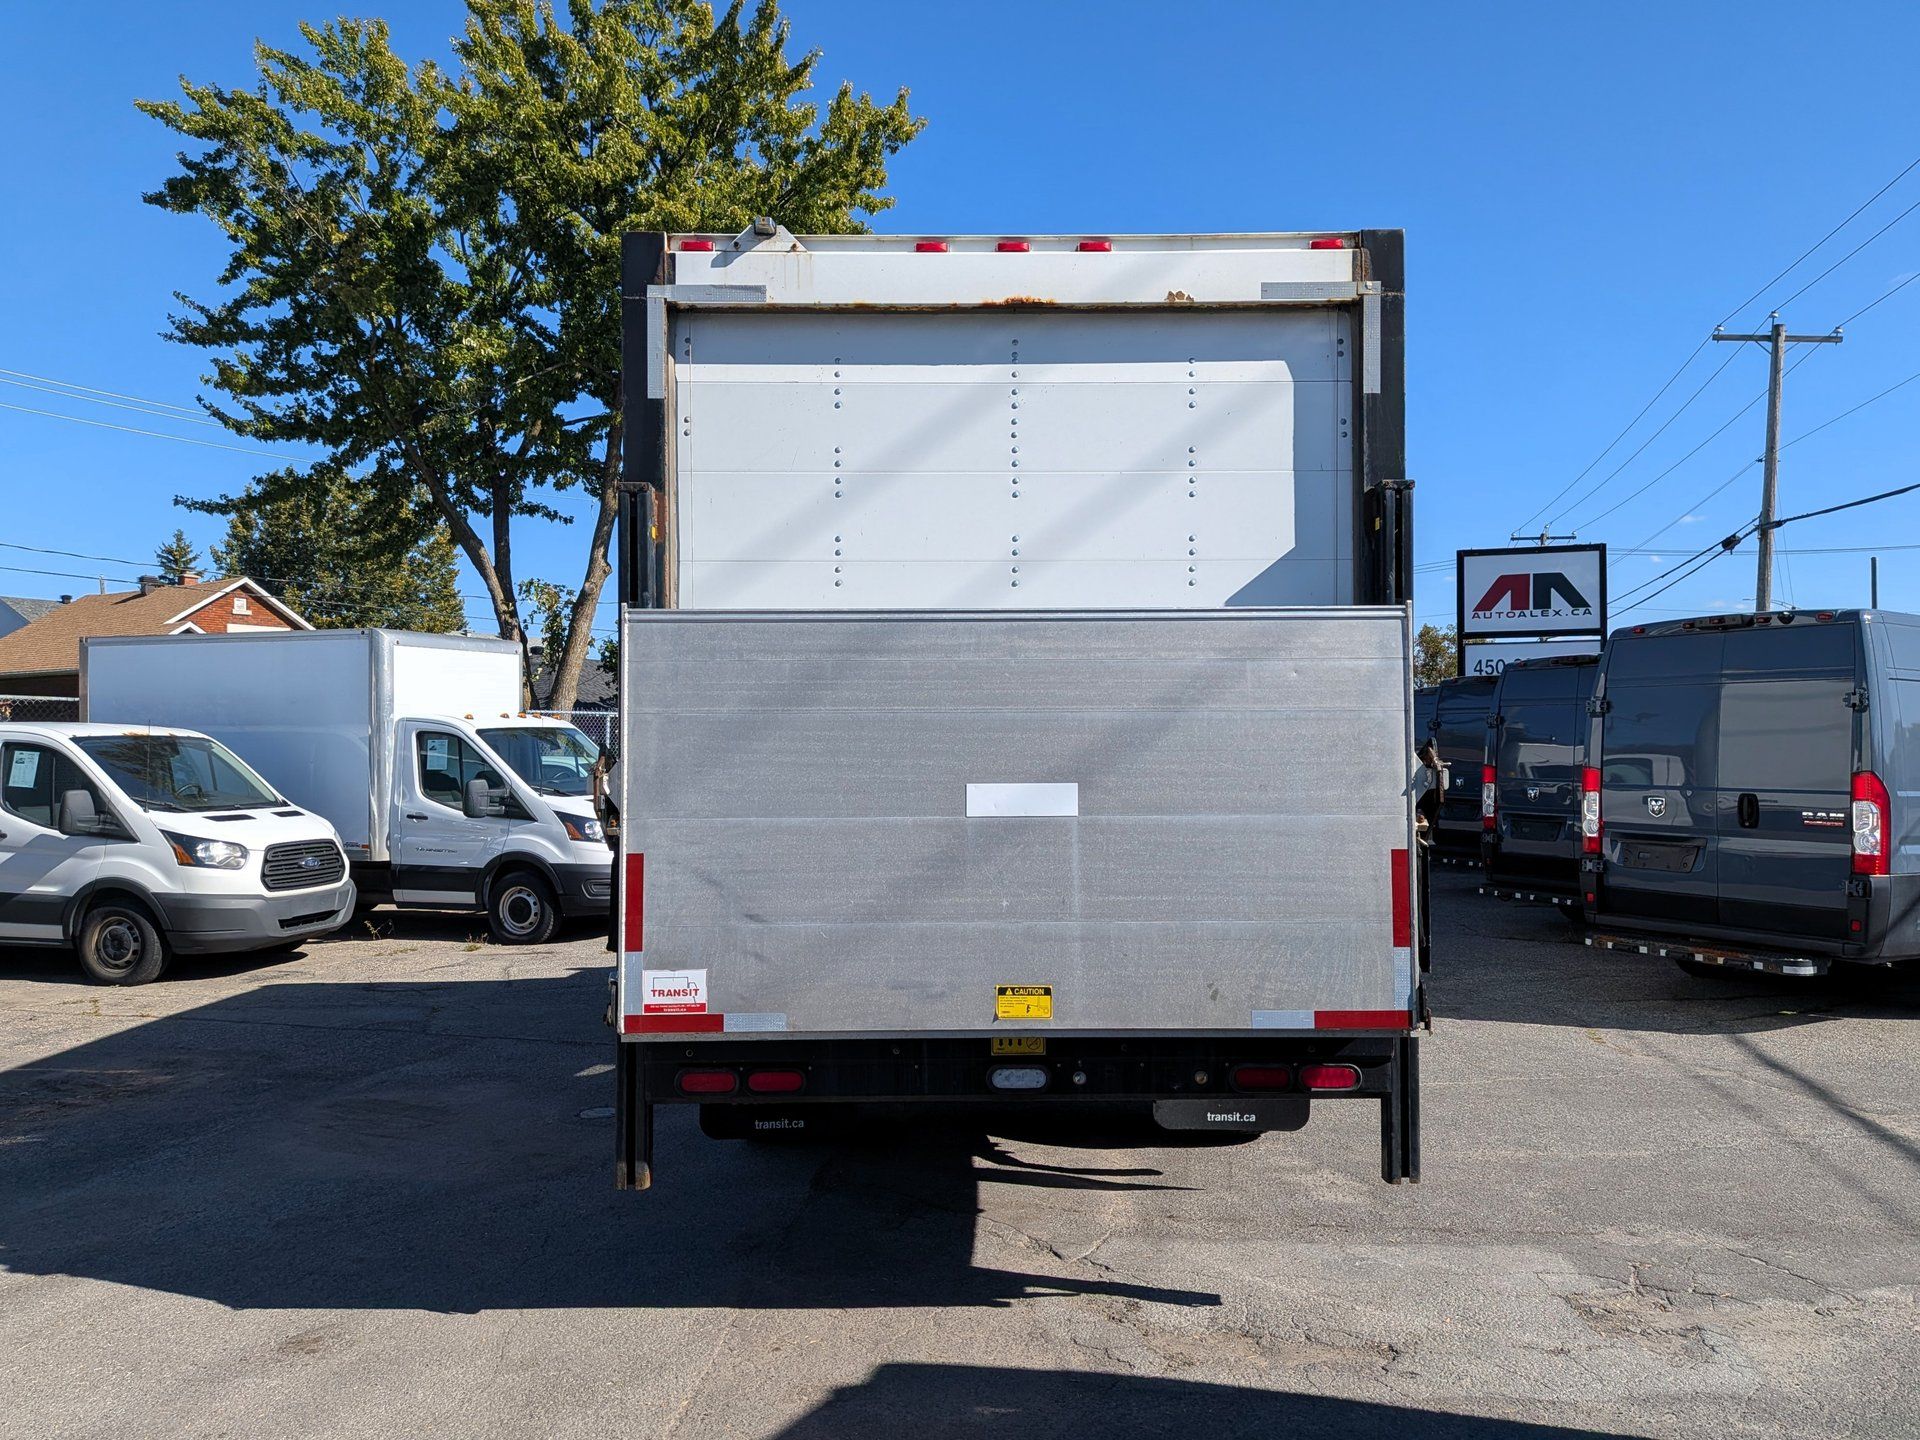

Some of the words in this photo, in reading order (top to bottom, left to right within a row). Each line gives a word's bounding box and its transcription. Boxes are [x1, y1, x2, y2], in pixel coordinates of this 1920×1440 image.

[1472, 608, 1592, 619] AUTOALEX.CA
[651, 988, 699, 997] TRANSIT
[1207, 1112, 1256, 1121] transit.ca
[755, 1118, 804, 1129] transit.ca
